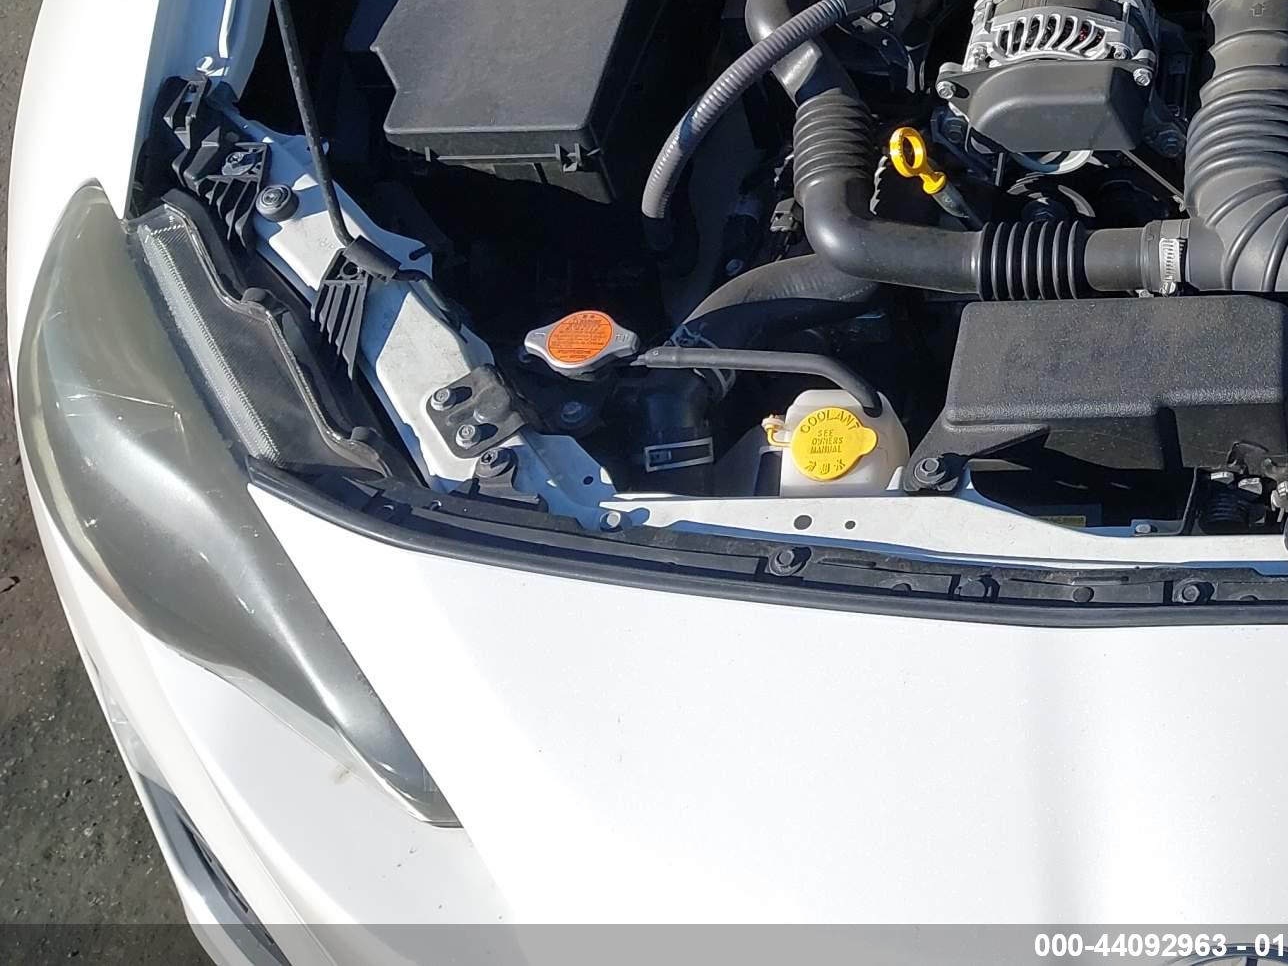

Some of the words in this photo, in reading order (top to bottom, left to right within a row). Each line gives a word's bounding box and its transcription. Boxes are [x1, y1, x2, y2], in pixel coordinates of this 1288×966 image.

[800, 410, 860, 433] COOLANT
[817, 429, 834, 437] SEE
[810, 445, 842, 454] MANUAL
